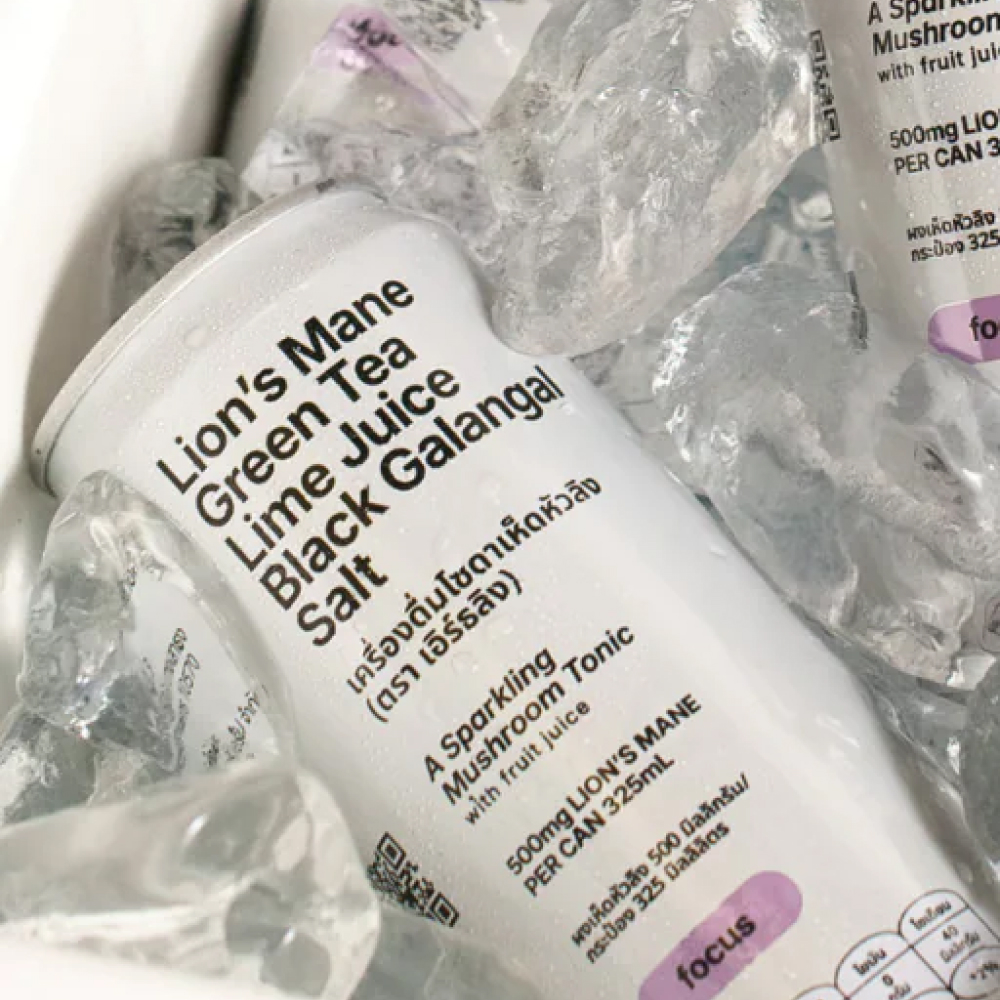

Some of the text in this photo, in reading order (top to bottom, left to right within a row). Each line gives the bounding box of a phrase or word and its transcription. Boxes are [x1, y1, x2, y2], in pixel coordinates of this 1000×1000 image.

[867, 2, 883, 26] A
[877, 62, 915, 84] with
[920, 50, 965, 75] fruit
[889, 120, 959, 150] 500mg
[894, 152, 930, 175] PER
[934, 140, 983, 169] CAN
[968, 228, 1000, 252] 325
[156, 278, 413, 493] Lion's Mane
[196, 337, 417, 527] Green Tea
[225, 368, 459, 571] Lime Juice
[258, 365, 566, 611] Black Galangal
[295, 553, 389, 646] Salt
[345, 477, 602, 695] เครื่องดื่มโซดาเห็ดหัวลิง
[365, 568, 523, 723] (ตรา เอิร์ธลิง)
[423, 647, 557, 782] A Sparkling
[441, 625, 635, 806] Mushroom Tonic
[465, 701, 591, 825] with fruit juice
[505, 693, 702, 876] 500mg LION'S MANE
[523, 754, 675, 898] PER CAN 325mL
[648, 832, 682, 866] 500
[632, 877, 666, 912] 325
[676, 911, 757, 988] focus
